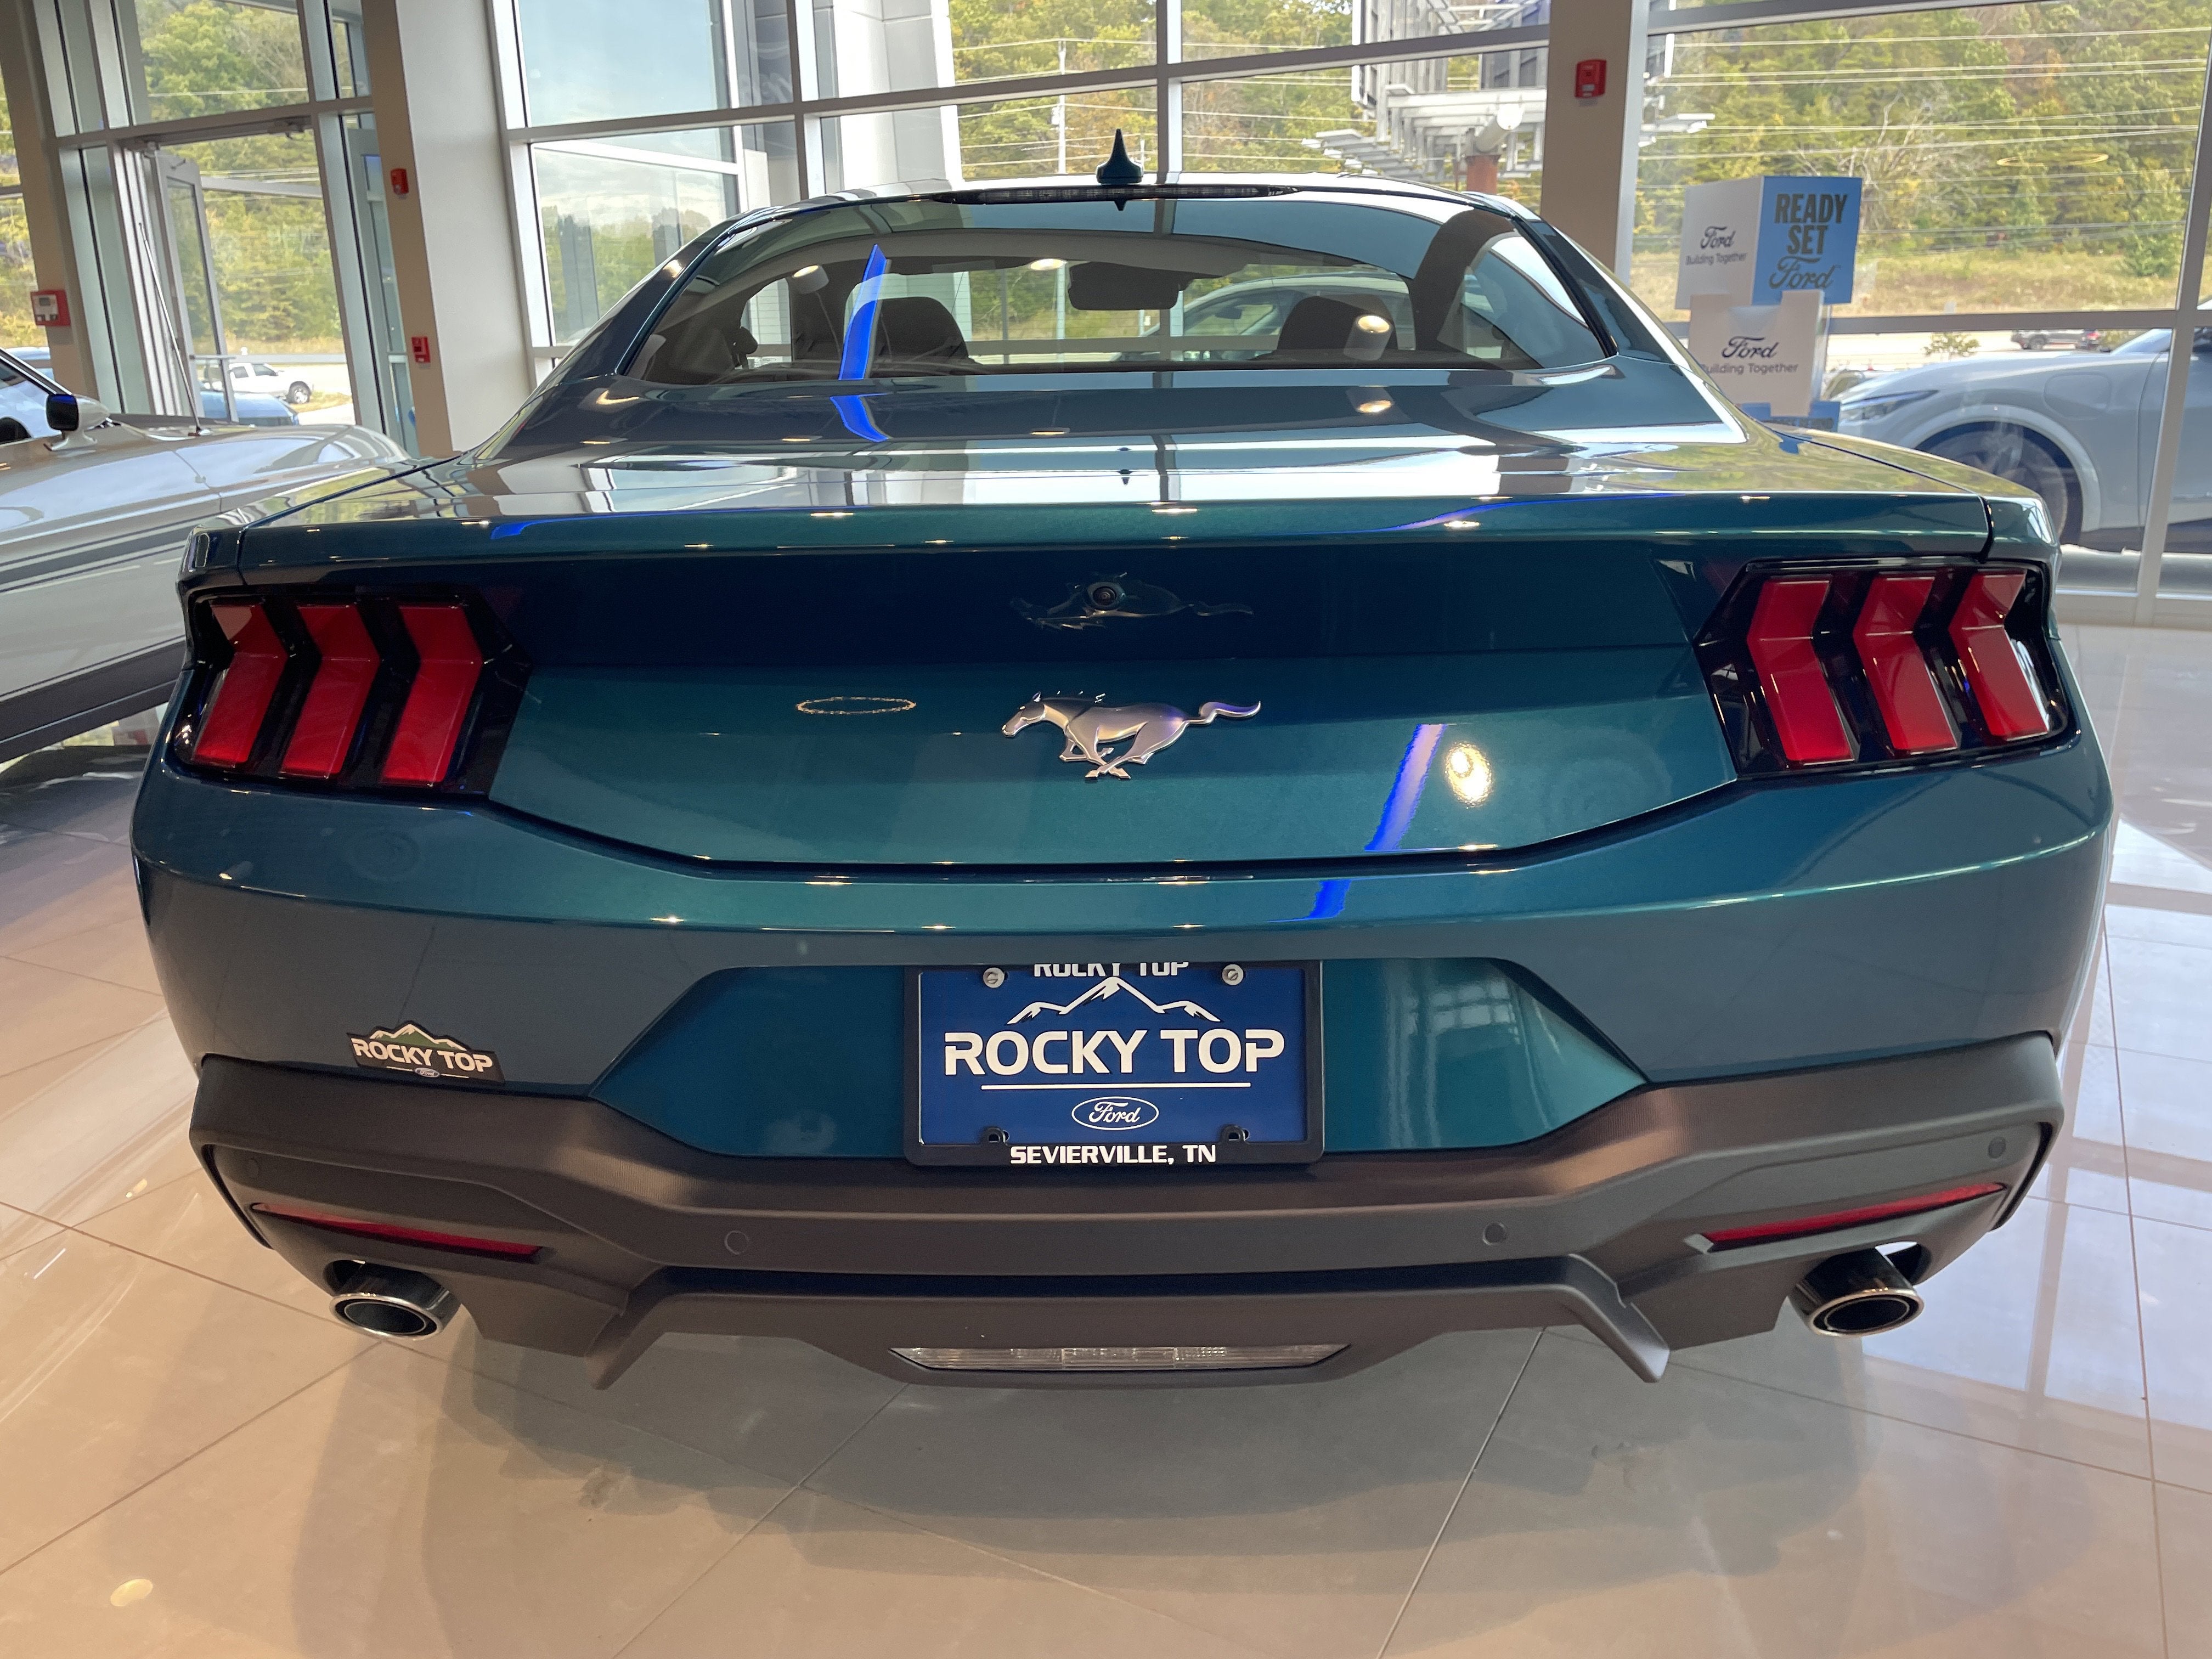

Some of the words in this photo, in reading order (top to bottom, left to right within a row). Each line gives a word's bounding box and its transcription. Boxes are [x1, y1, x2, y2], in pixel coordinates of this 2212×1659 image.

[1774, 193, 1848, 224] READY
[1700, 226, 1736, 249] Ford
[1787, 225, 1828, 255] SET
[1685, 255, 1714, 266] Building
[1768, 255, 1835, 289] Ford
[1722, 336, 1779, 358] Ford
[1748, 362, 1798, 375] Together
[351, 1037, 432, 1066] ROCKY
[437, 1049, 493, 1072] TOP
[945, 1030, 1147, 1075] ROCKY
[1160, 1028, 1285, 1073] TOP
[1088, 1101, 1141, 1123] Ford
[1010, 1145, 1175, 1165] SEVIERVILLE,
[1182, 1144, 1216, 1163] TN
